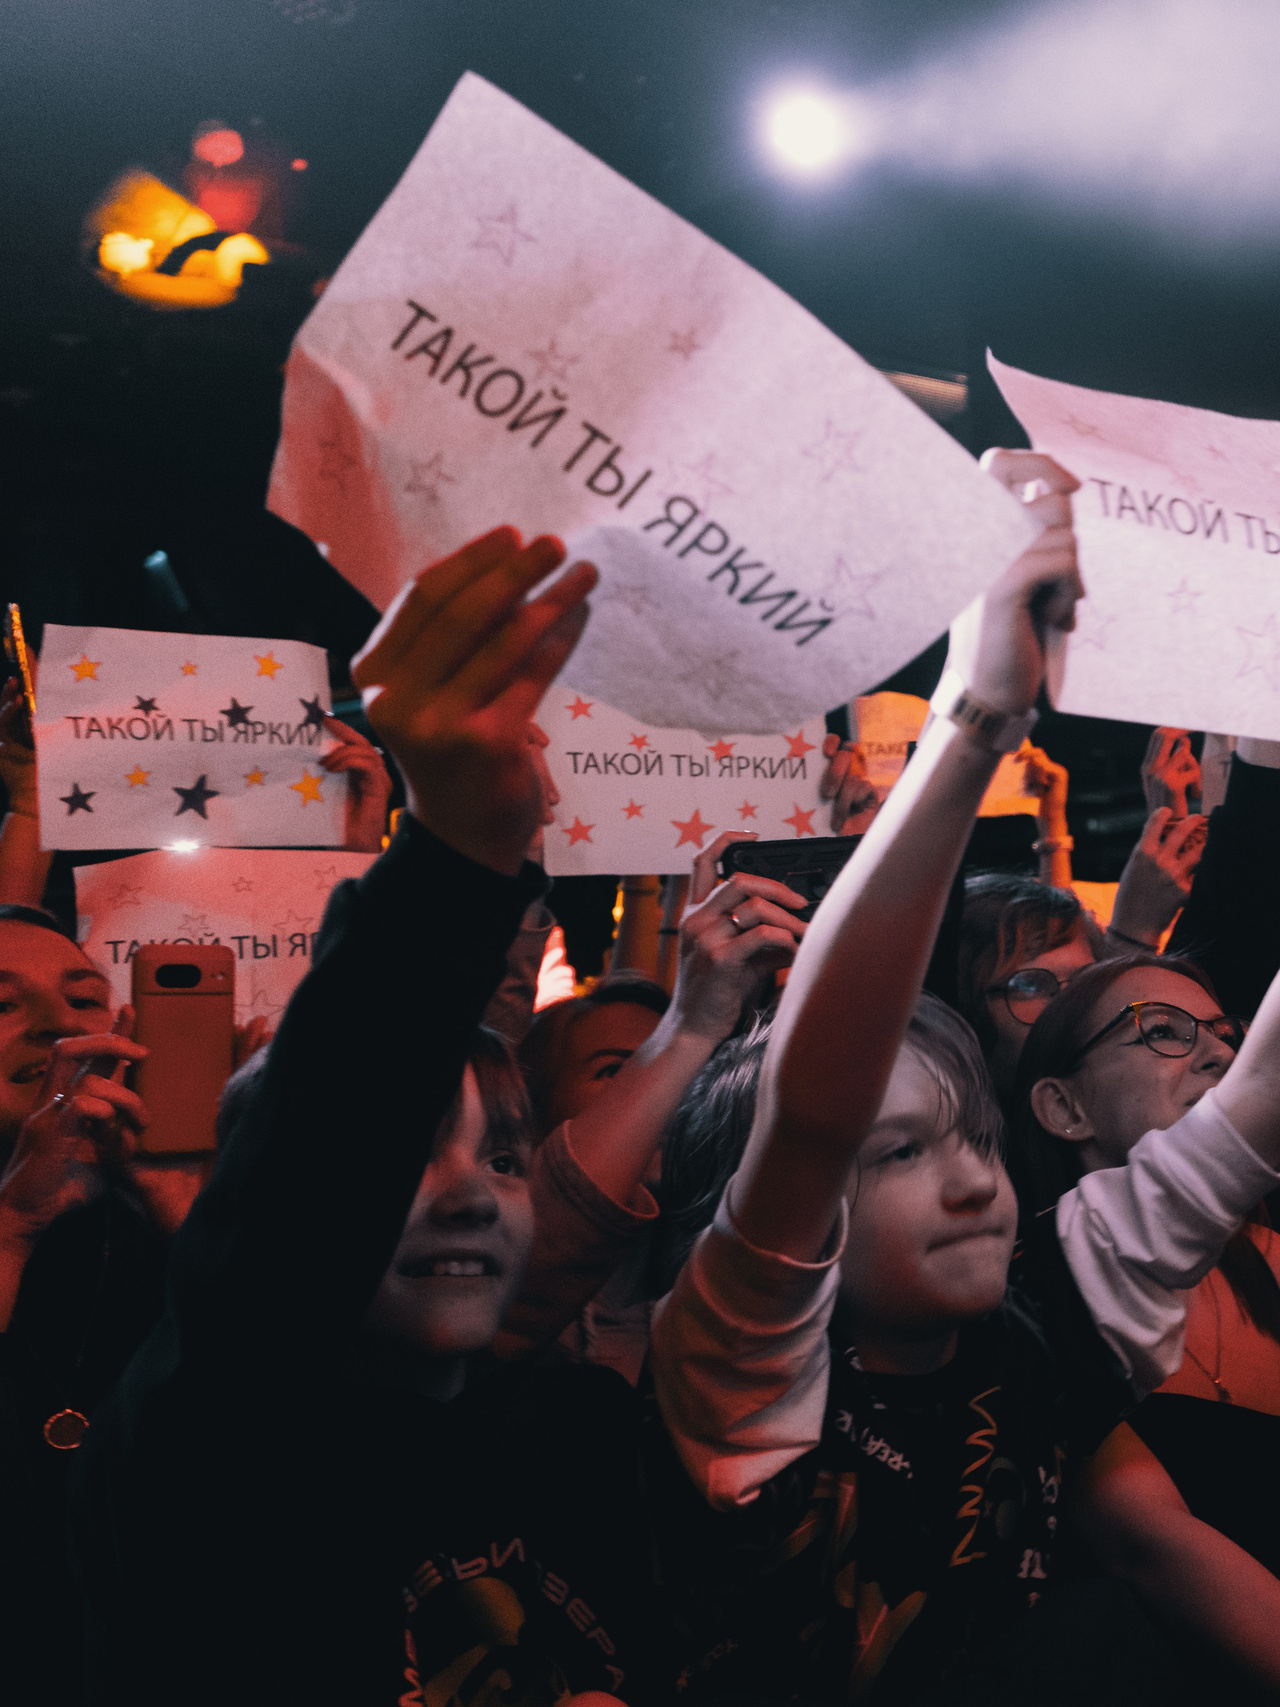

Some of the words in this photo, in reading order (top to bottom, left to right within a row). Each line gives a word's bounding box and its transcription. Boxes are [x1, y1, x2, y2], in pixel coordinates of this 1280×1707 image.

[390, 299, 568, 448] ТАКОЙ
[563, 421, 652, 510] ТЫ
[643, 495, 833, 648] ЯРКИЙ
[1089, 477, 1229, 543] ТАКОЙ
[64, 713, 174, 741] ТАКОЙ
[181, 718, 225, 743] ТЫ
[566, 750, 664, 777] ТАКОЙ
[669, 754, 709, 777] ТЫ
[717, 754, 808, 780] ЯРКИЙ
[230, 935, 278, 960] ТЫ
